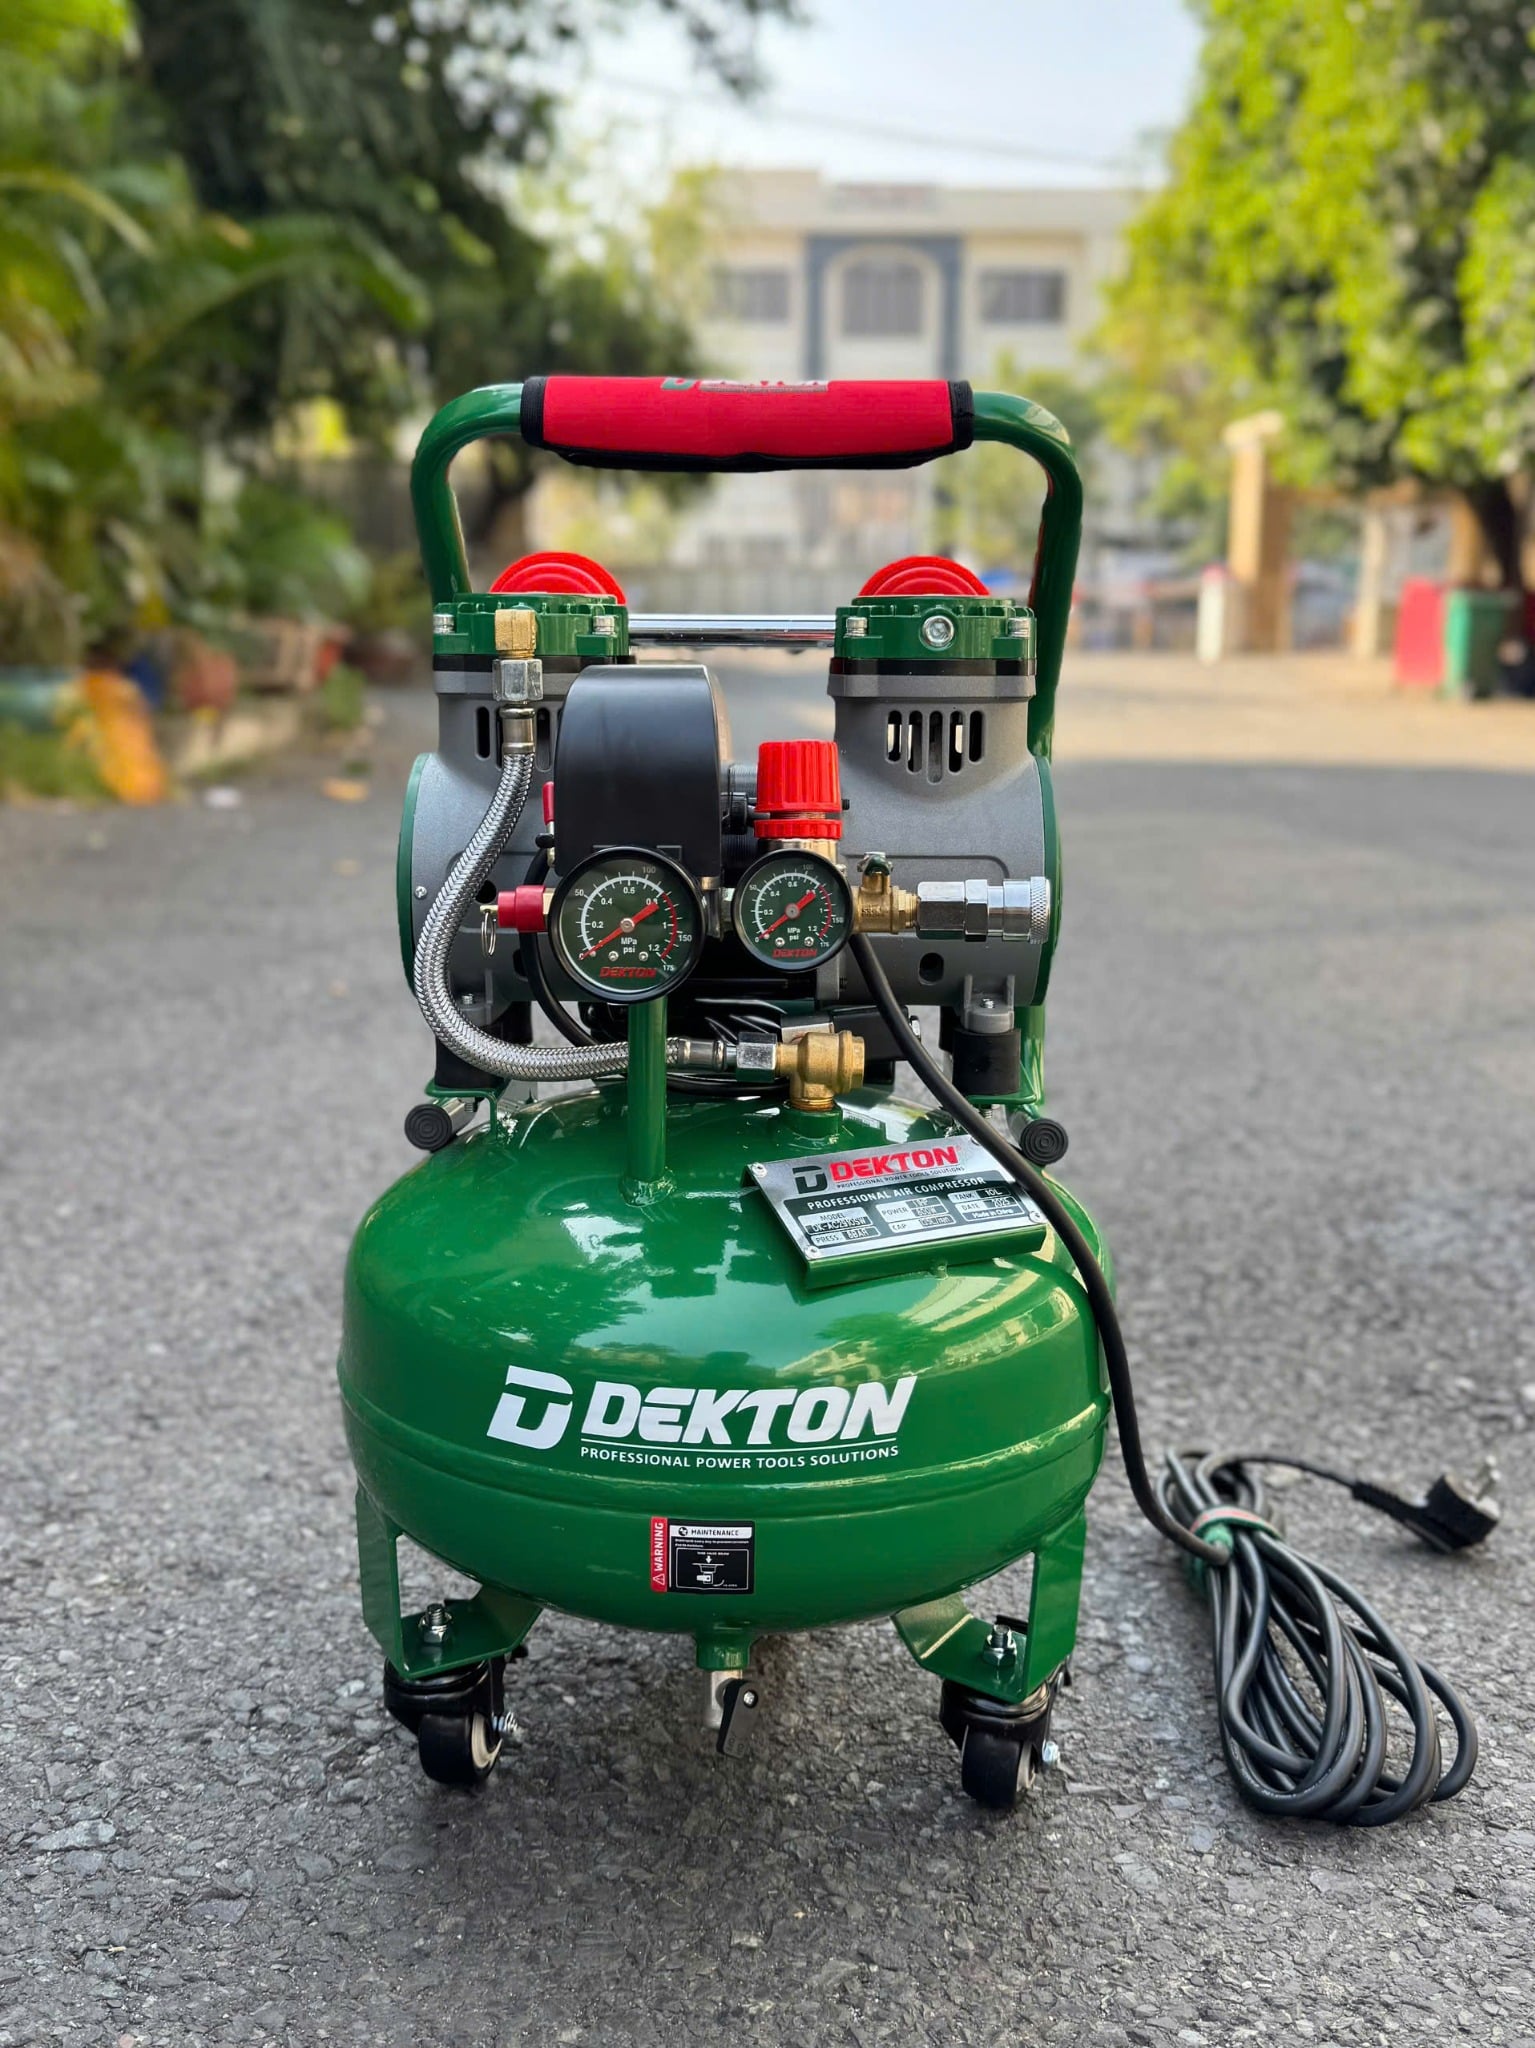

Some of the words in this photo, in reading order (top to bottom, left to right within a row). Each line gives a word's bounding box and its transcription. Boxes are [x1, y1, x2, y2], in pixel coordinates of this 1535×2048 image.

[642, 866, 657, 874] 100
[591, 921, 604, 929] 0.2
[620, 937, 638, 945] MPa
[623, 946, 636, 954] psi
[648, 944, 660, 952] 1.2
[599, 966, 658, 978] DEKTON
[829, 1145, 959, 1182] DEKTON
[836, 1176, 884, 1189] PROFESSIONAL
[884, 1173, 908, 1183] POWER
[908, 1170, 930, 1179] TOOLS
[930, 1165, 966, 1177] SOLUTIONS
[807, 1190, 892, 1210] PROFESSIONAL
[893, 1186, 913, 1197] AIR
[915, 1177, 986, 1194] COMPRESSOR
[985, 1188, 1003, 1196] 10L
[881, 1206, 908, 1216] POWER
[961, 1203, 981, 1211] DATE
[820, 1212, 847, 1221] MODEL
[580, 1376, 918, 1445] DEKTON
[580, 1446, 691, 1469] PROFESSIONAL
[695, 1457, 752, 1470] POWER
[755, 1456, 806, 1469] TOOLS
[810, 1445, 899, 1467] SOLUTIONS
[691, 1529, 739, 1537] MAINTENANCE
[654, 1522, 664, 1572] WARNING
